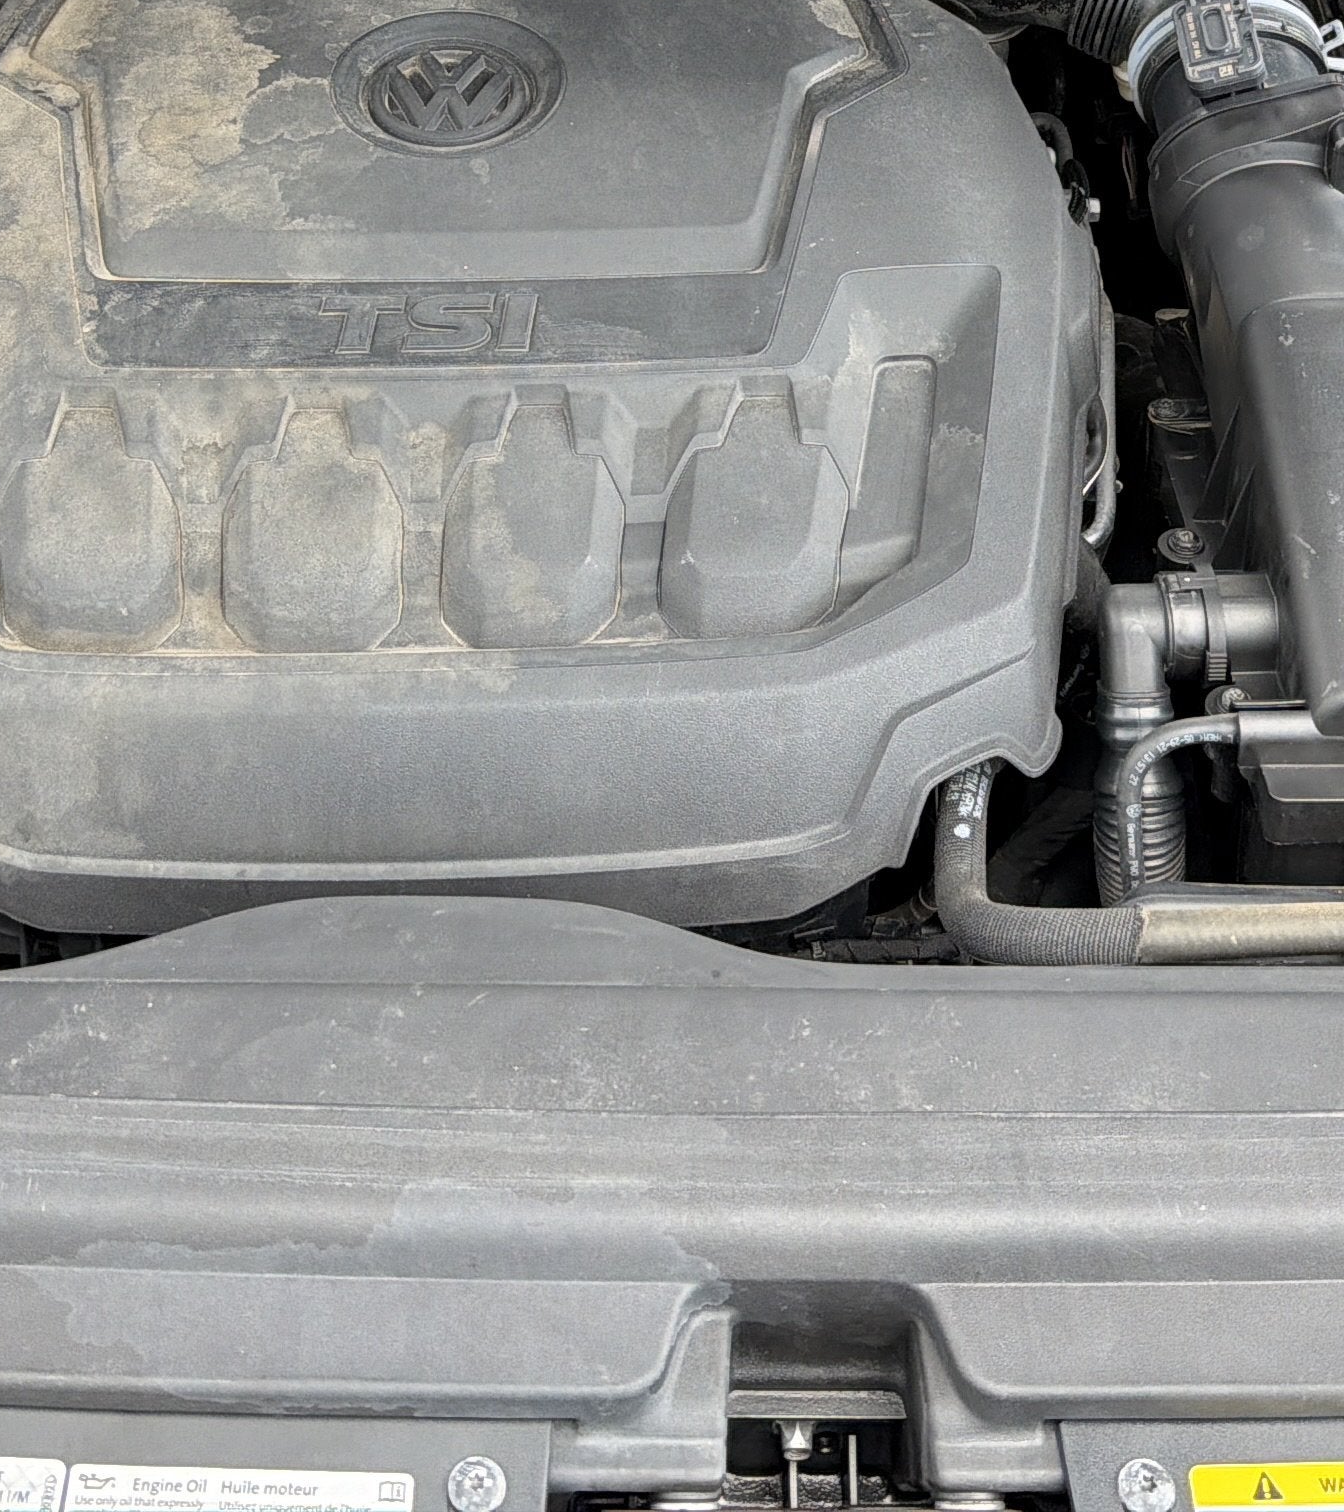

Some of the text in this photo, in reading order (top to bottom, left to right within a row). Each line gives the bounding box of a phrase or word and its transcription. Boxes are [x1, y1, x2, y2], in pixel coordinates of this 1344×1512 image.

[317, 292, 540, 355] TSI
[133, 1478, 319, 1496] Engine Oil Huile moteur
[75, 1495, 94, 1506] Use
[95, 1497, 117, 1508] only
[134, 1497, 156, 1507] that
